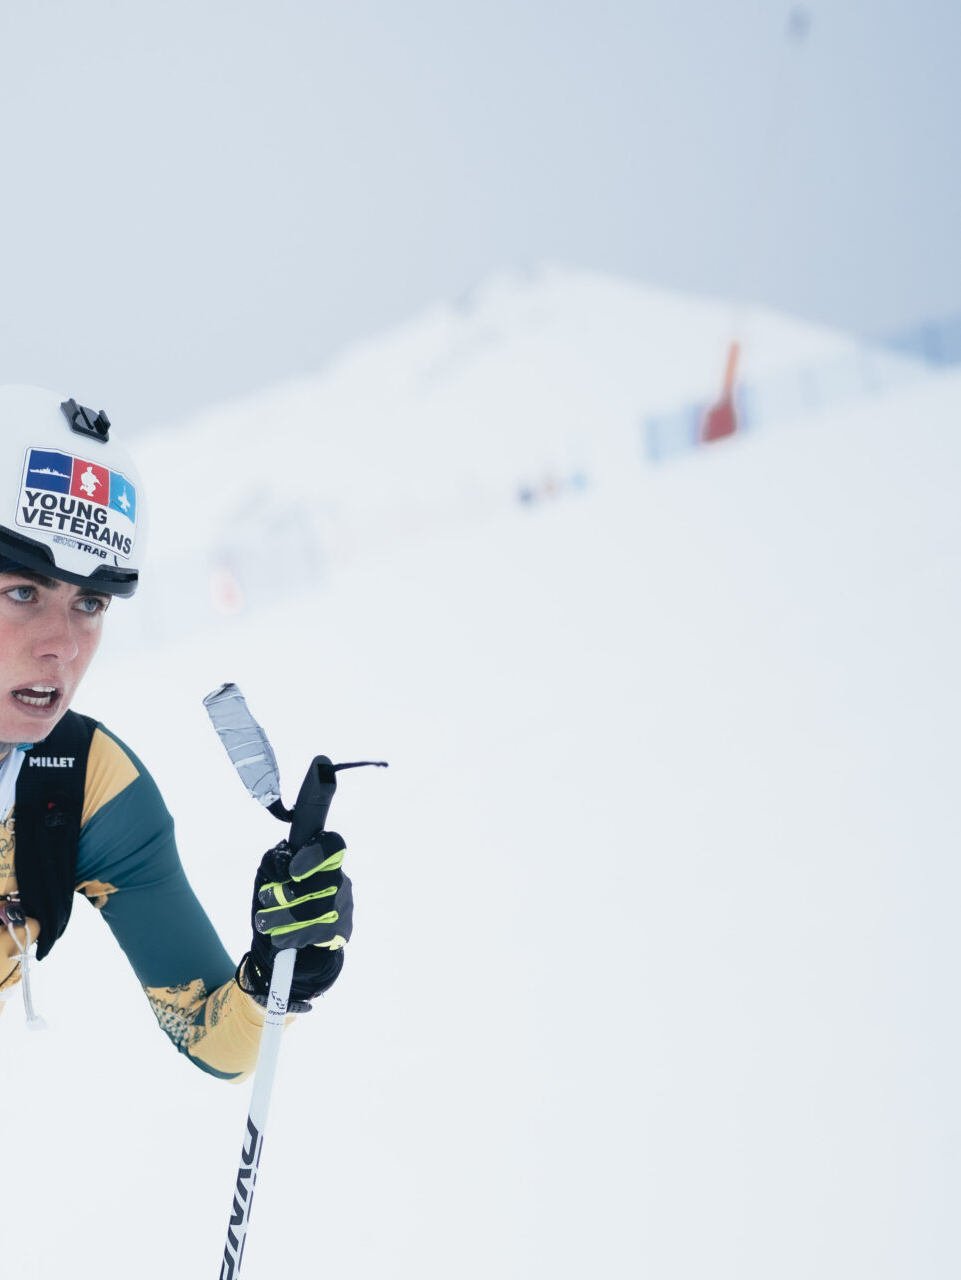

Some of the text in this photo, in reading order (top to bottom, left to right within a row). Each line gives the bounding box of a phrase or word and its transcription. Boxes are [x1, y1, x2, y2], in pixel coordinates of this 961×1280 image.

[25, 490, 108, 525] YOUNG
[22, 506, 132, 555] VETERANS
[29, 756, 75, 768] MILLET
